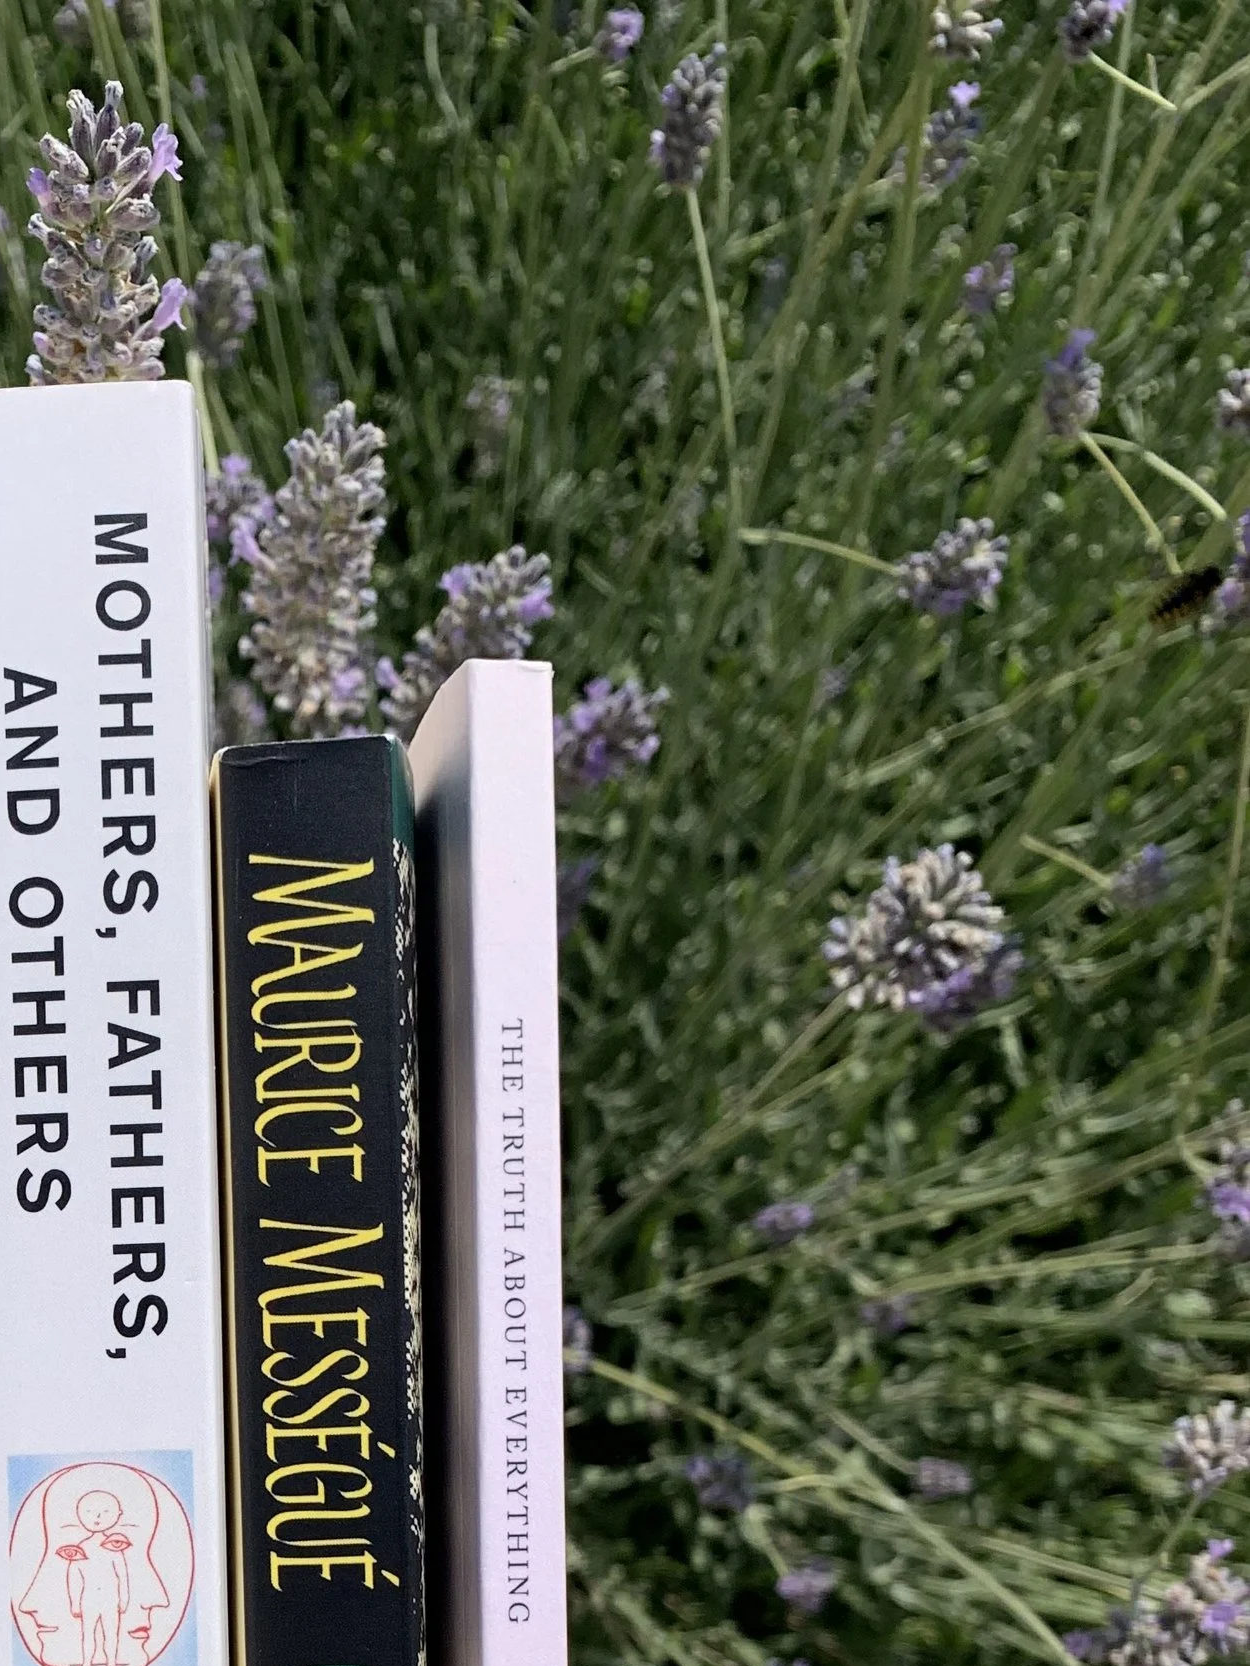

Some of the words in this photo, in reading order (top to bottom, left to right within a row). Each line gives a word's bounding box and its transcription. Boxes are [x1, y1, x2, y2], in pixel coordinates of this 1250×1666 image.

[4, 668, 60, 835] AND
[95, 513, 159, 938] MOTHERS,
[9, 877, 71, 1212] OTHERS
[248, 855, 375, 1186] MAURICE
[502, 1019, 523, 1091] THE
[106, 980, 168, 1358] FATHERS,
[503, 1107, 525, 1230] TRUTH
[504, 1249, 527, 1370] ABOUT
[258, 1217, 401, 1591] MESSÉGUÉ
[506, 1387, 529, 1622] EVERYTHING
